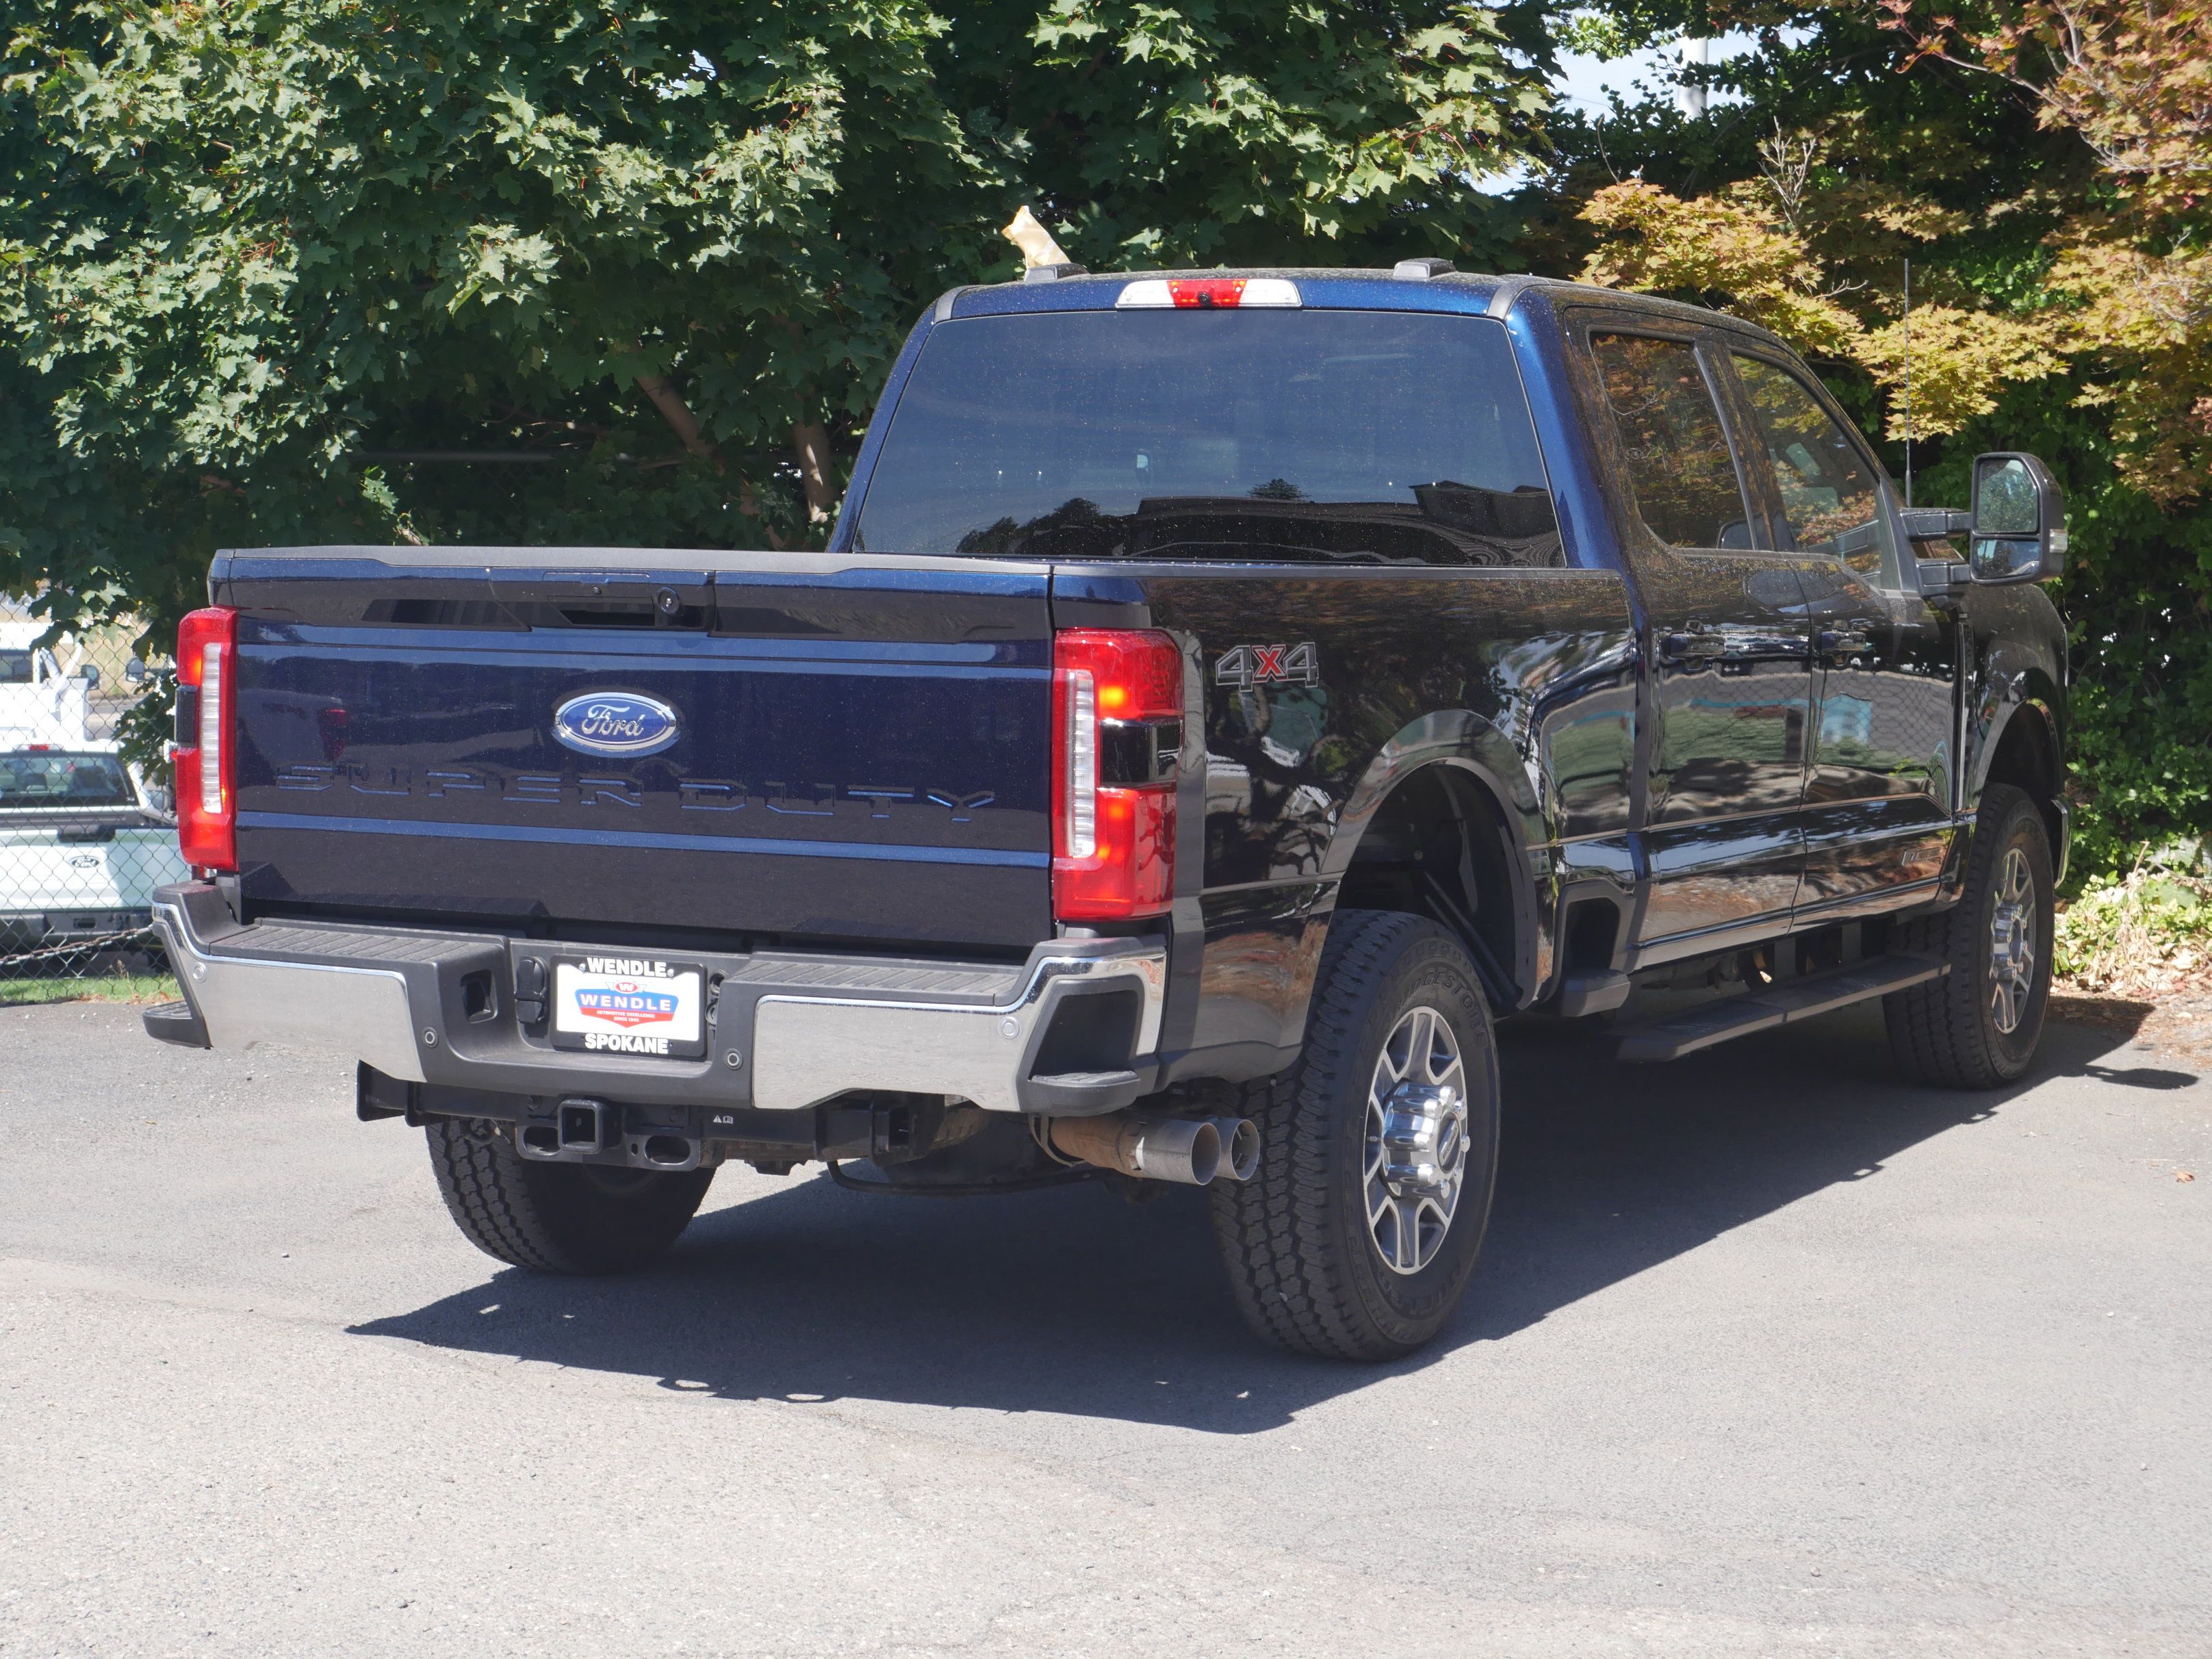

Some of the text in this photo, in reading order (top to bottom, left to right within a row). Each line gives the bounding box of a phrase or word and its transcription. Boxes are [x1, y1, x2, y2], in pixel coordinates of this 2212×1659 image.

[582, 704, 645, 737] Ford
[276, 761, 996, 821] SUPER DUTY
[587, 957, 667, 977] WENDLE
[580, 994, 671, 1011] WENDLE
[585, 1033, 669, 1055] SPOKANE
